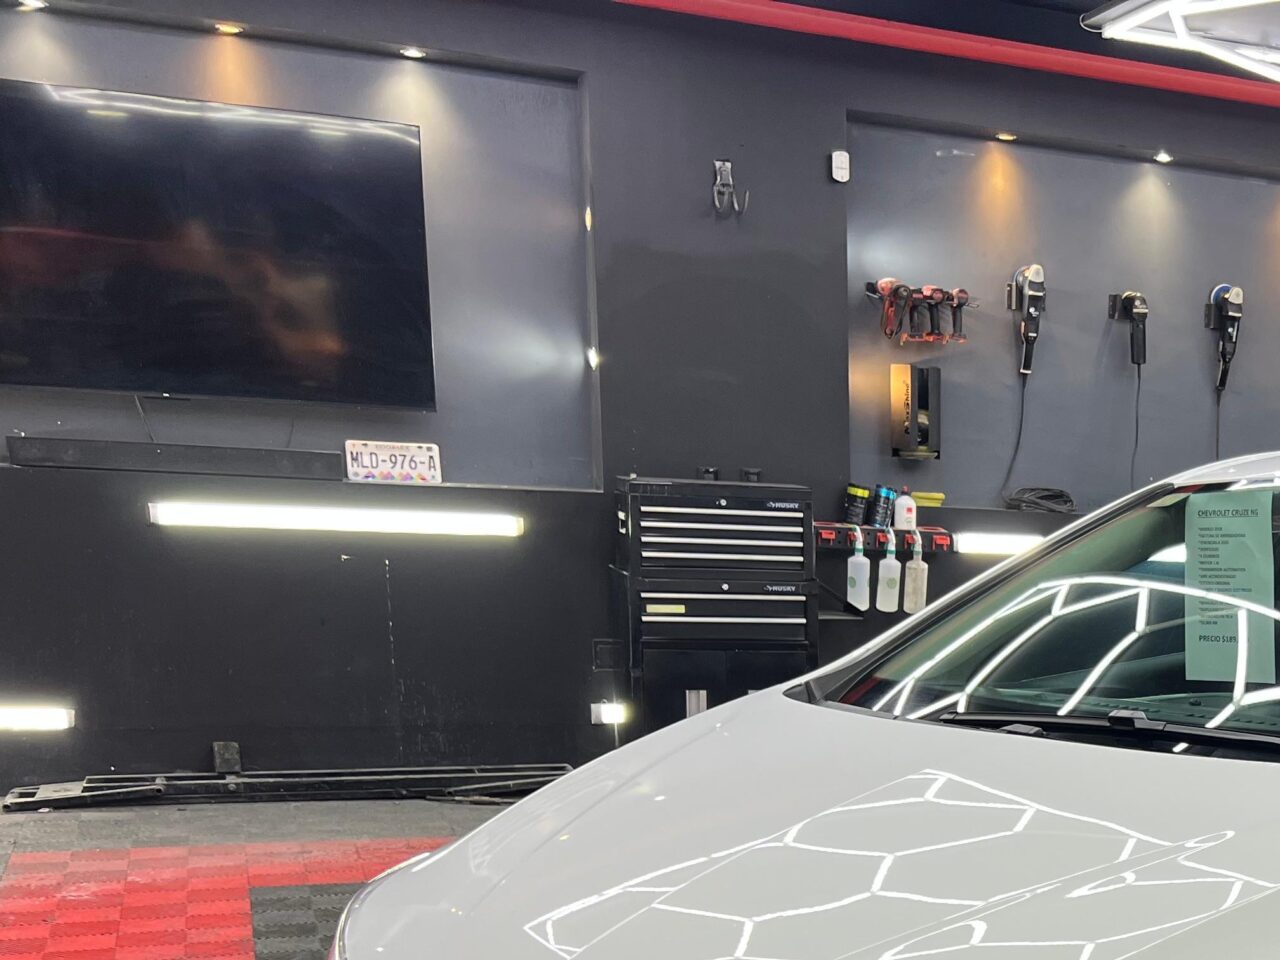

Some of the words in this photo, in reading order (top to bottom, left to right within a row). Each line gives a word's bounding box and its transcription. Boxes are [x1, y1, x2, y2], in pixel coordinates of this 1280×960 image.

[350, 450, 437, 472] MLD-976-A
[1197, 509, 1230, 517] CHEVROLET
[1199, 634, 1220, 642] PRECIO
